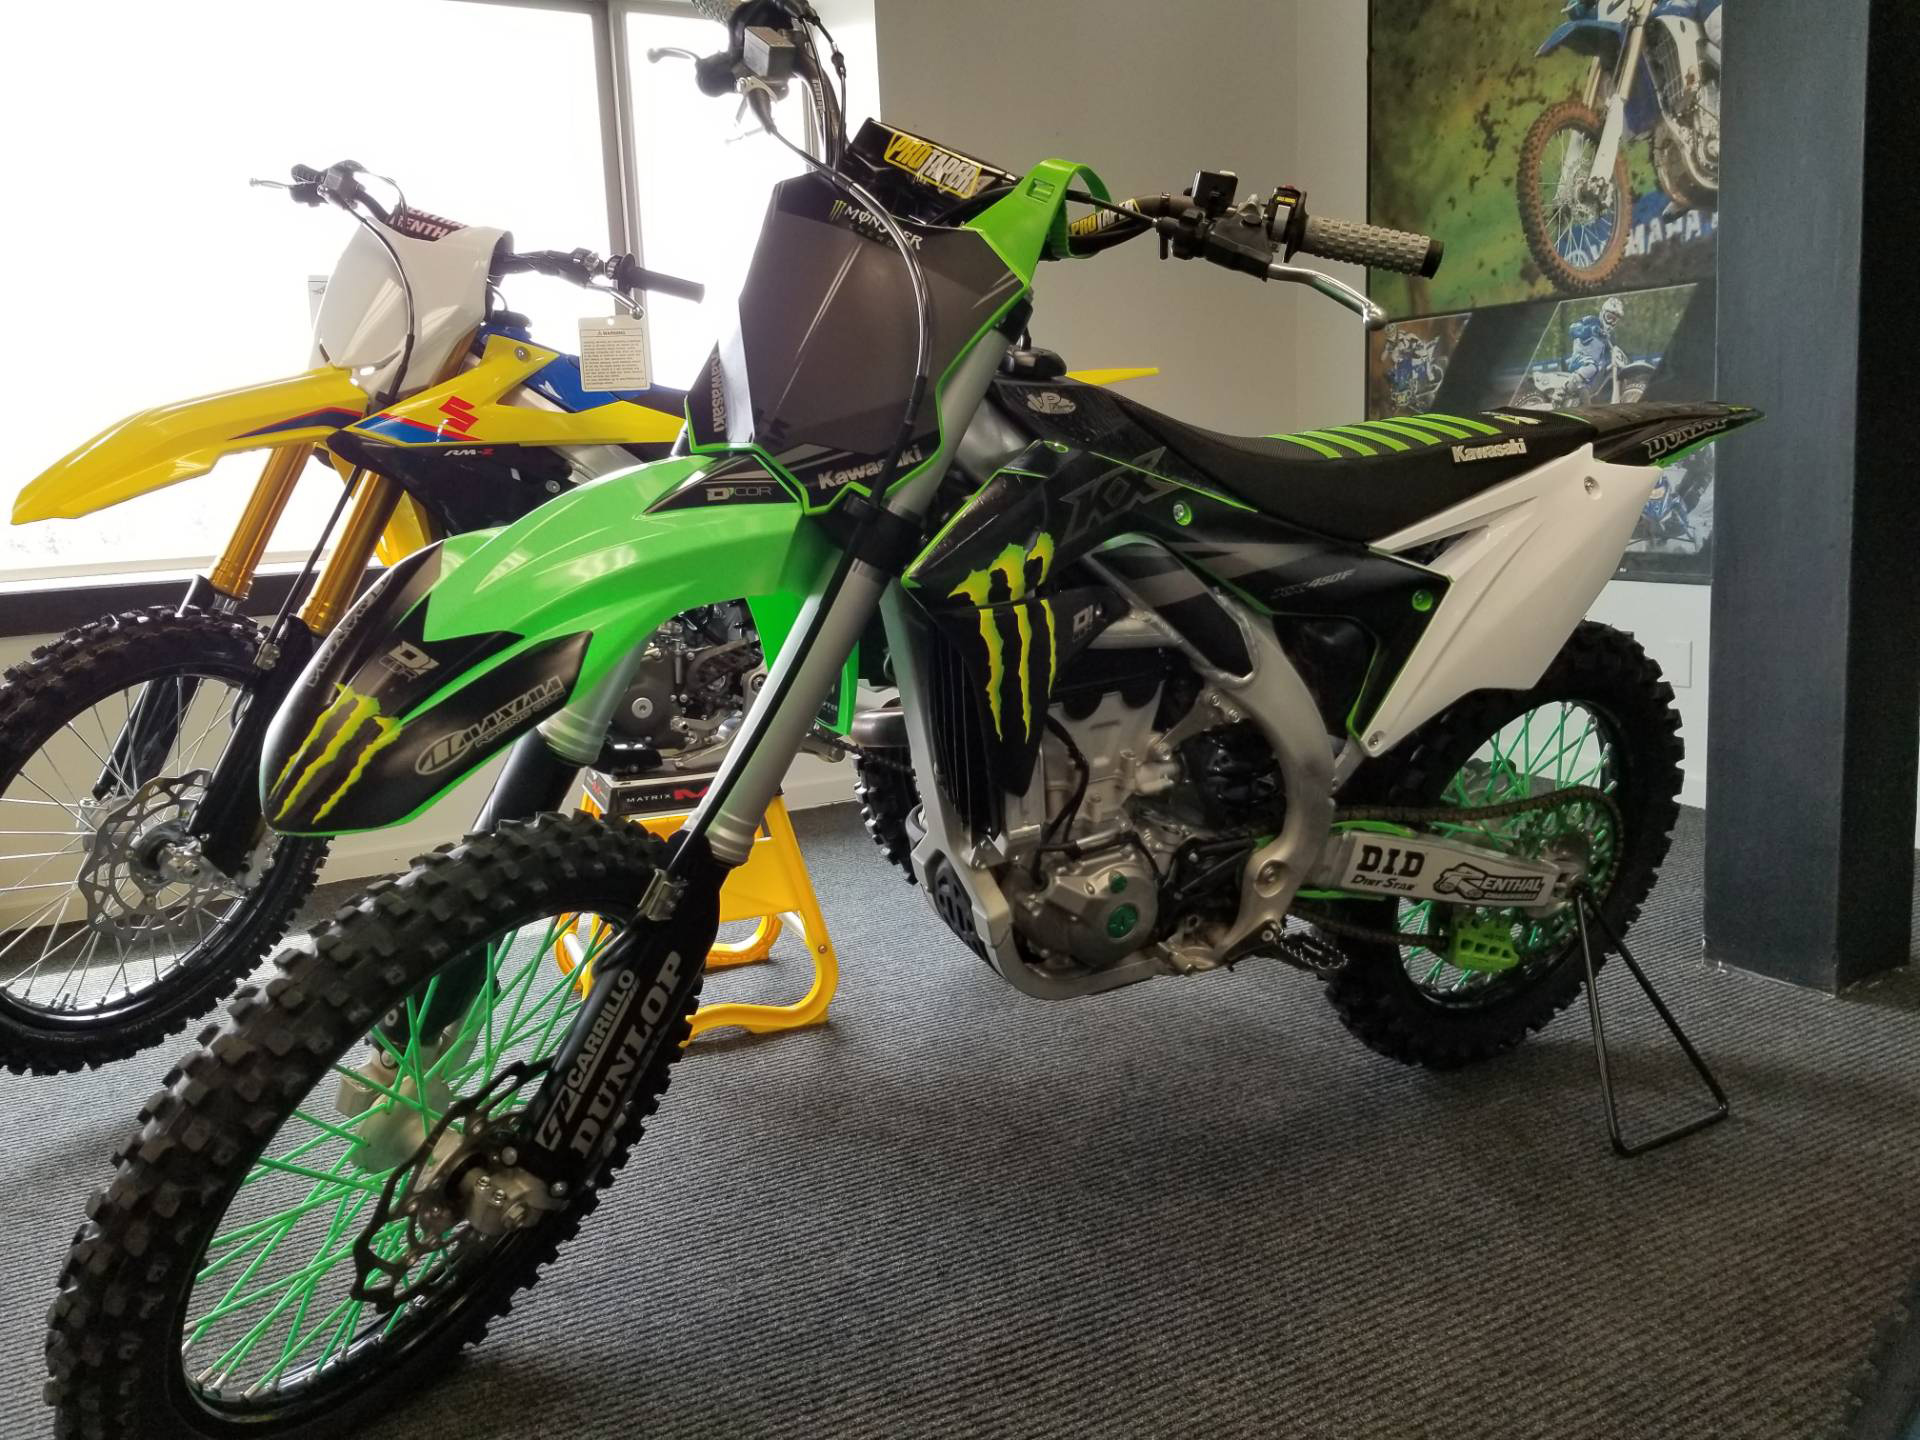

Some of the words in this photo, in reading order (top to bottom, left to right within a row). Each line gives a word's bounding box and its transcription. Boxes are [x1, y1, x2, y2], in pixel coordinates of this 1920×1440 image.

[1451, 438, 1528, 463] Kawasaki
[627, 793, 671, 803] MATRIX
[1357, 844, 1425, 878] D.I.D
[566, 969, 636, 1089] CARRILLO
[570, 951, 683, 1159] DUNLOP
